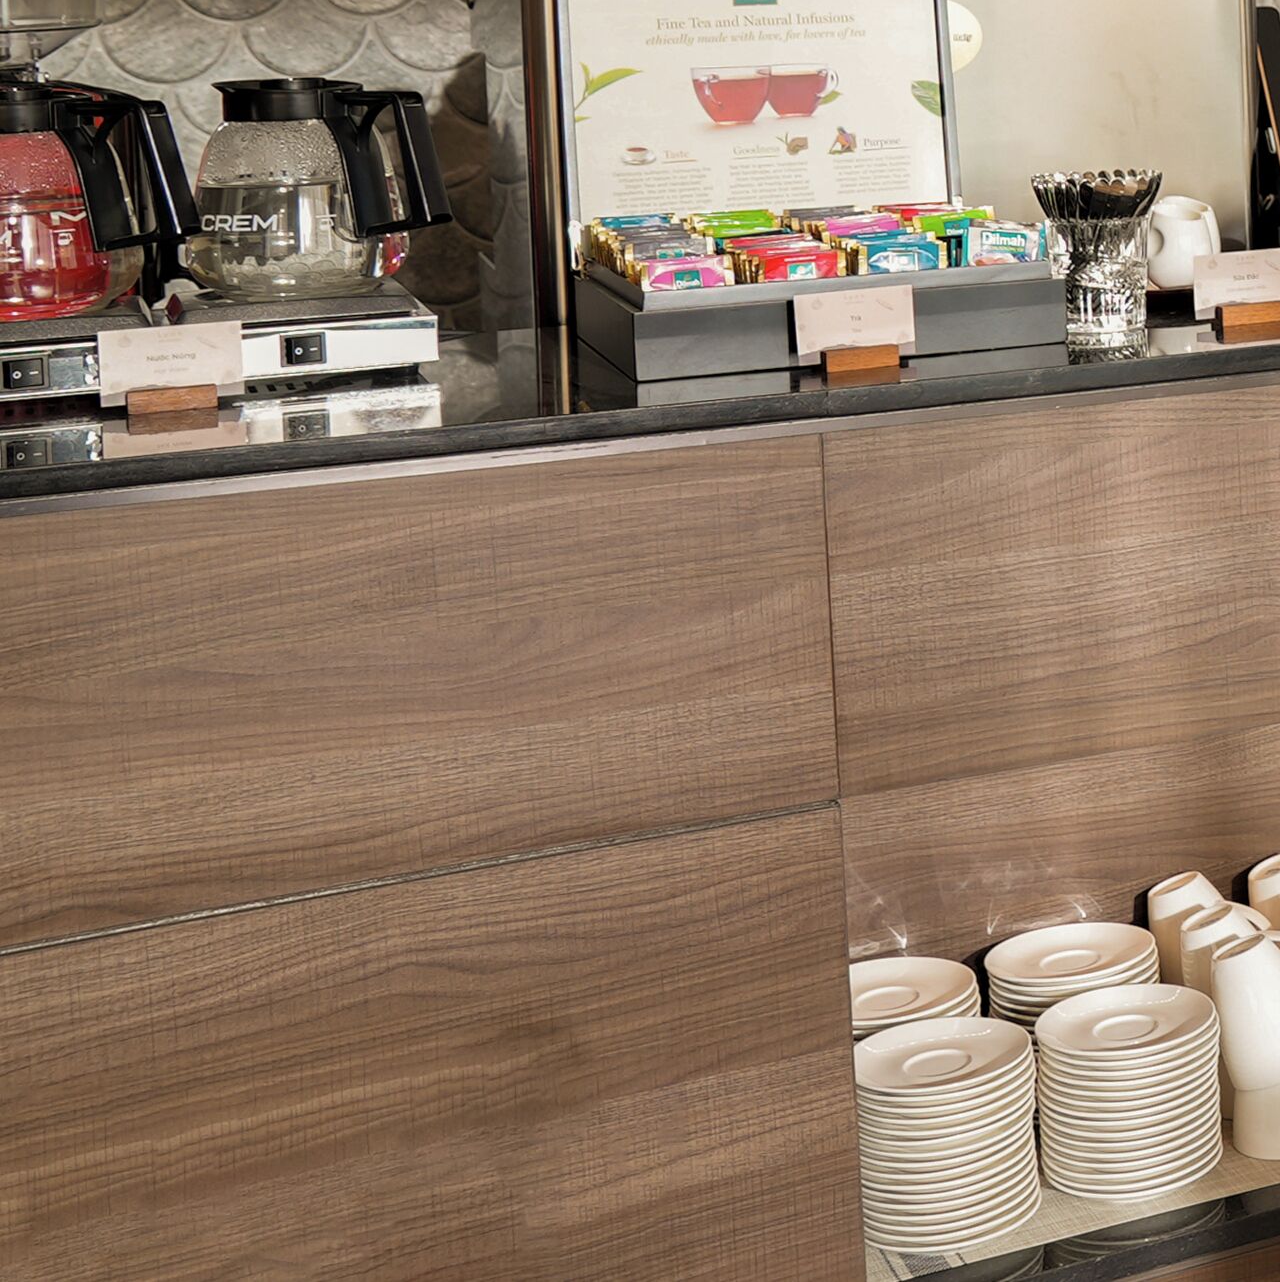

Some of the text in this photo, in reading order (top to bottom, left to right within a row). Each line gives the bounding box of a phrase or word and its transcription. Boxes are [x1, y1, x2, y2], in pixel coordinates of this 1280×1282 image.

[656, 12, 855, 30] Fine Tea and Natural Infusions
[645, 27, 866, 46] ethically made with love, for lovers of tea
[733, 145, 780, 155] Goodness
[864, 138, 901, 148] Purpose
[663, 149, 689, 158] Taste
[201, 214, 278, 231] CREM
[982, 231, 1025, 247] Dilmah
